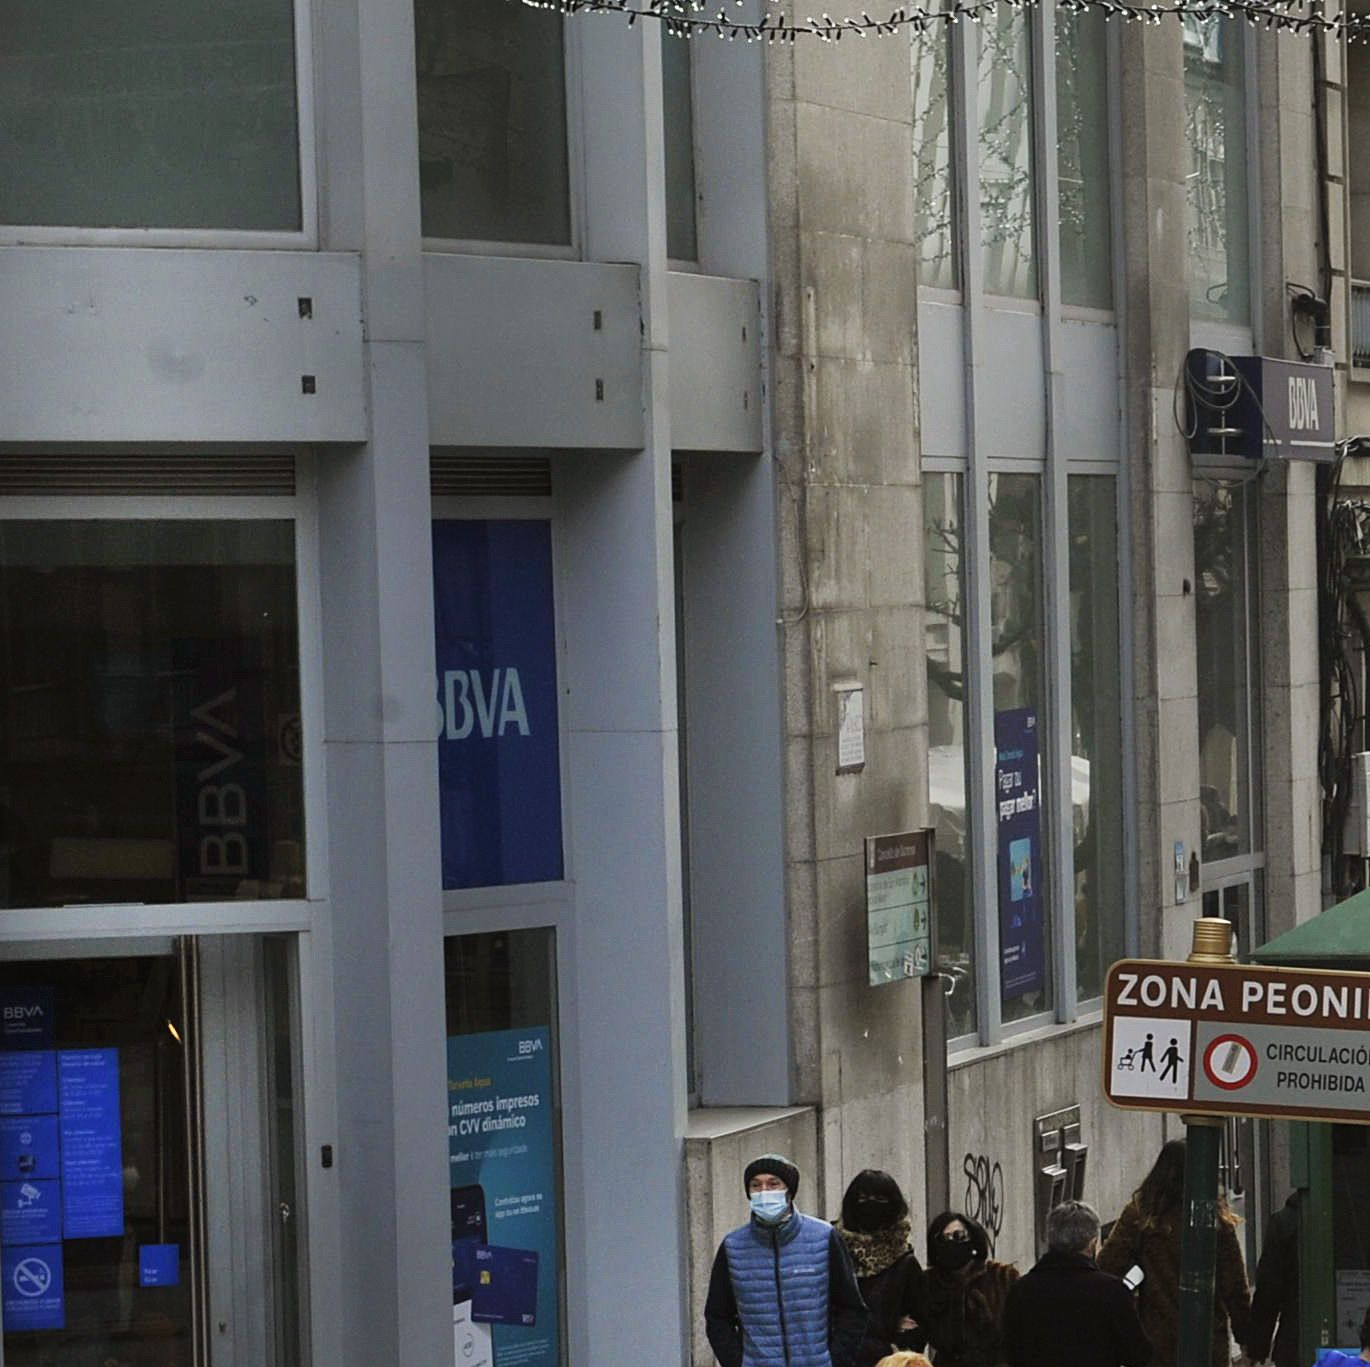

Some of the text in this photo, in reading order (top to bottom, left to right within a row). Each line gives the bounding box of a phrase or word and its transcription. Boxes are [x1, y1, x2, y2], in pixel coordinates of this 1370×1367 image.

[1288, 376, 1320, 431] BBVA
[437, 667, 531, 741] BVA
[1117, 973, 1225, 1011] ZONA
[4, 1006, 43, 1020] BBVA
[518, 1039, 543, 1054] BBVA
[1277, 1071, 1365, 1093] PROHIBIDA
[452, 1094, 540, 1117] números impresos
[460, 1118, 480, 1135] CVV
[482, 1113, 526, 1132] dinámico
